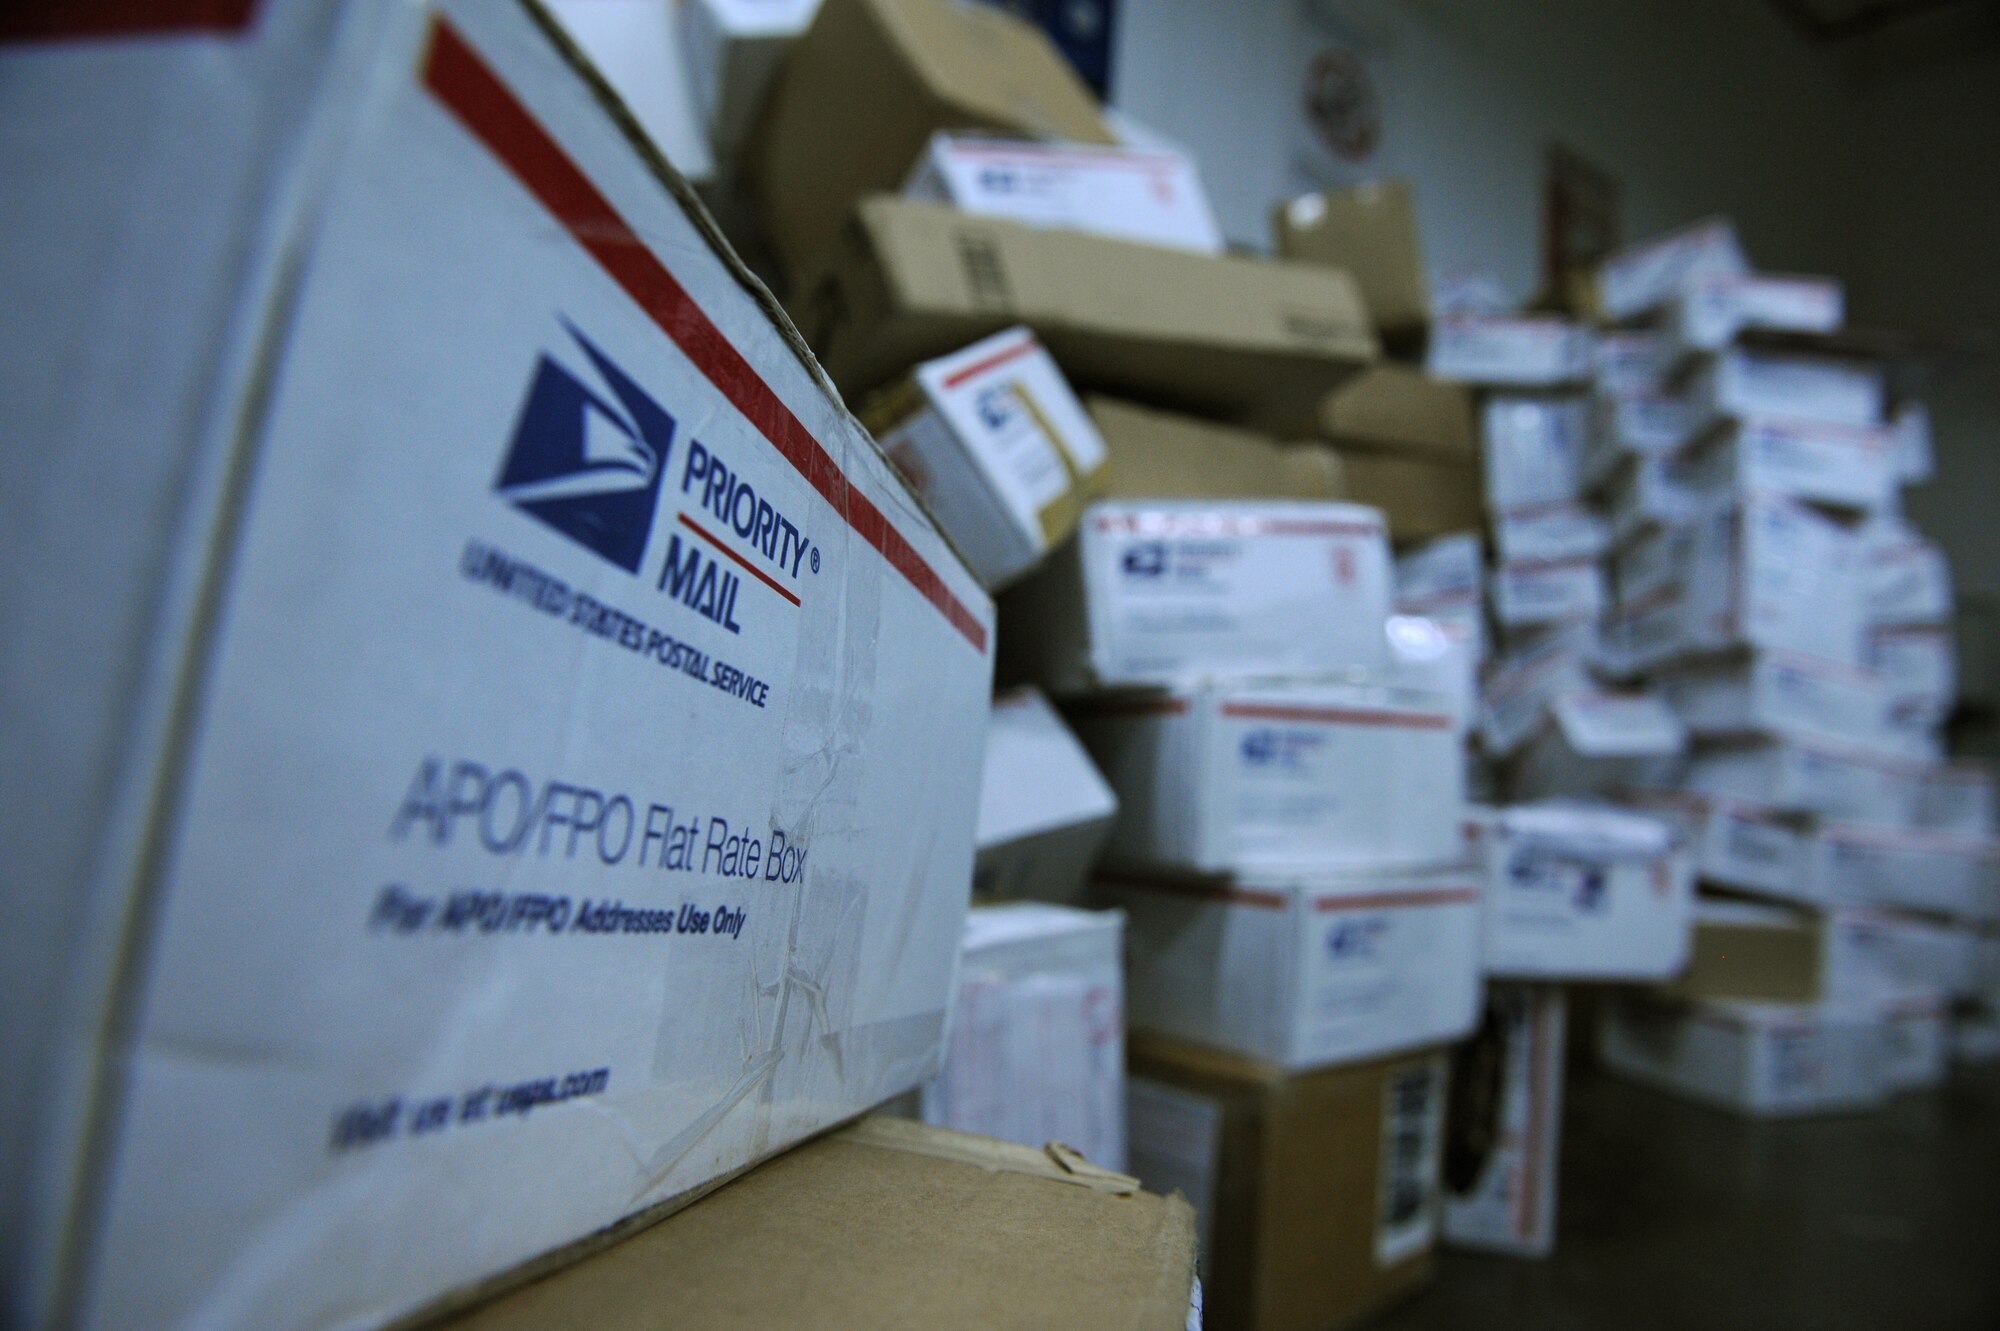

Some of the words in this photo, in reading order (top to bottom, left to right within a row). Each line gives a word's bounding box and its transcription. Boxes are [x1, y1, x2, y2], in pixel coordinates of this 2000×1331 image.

[658, 533, 740, 635] MAIL
[568, 591, 646, 652] STATES
[644, 628, 709, 683] POSTAL
[711, 660, 770, 708] SERVICE
[389, 756, 635, 866] APO/FPO
[638, 803, 700, 872] Flat
[702, 816, 761, 879] Rate
[765, 829, 808, 884] Box
[438, 890, 572, 935] APO/FPO
[571, 899, 675, 933] Addresses
[677, 903, 711, 934] Use
[713, 904, 746, 940] Only
